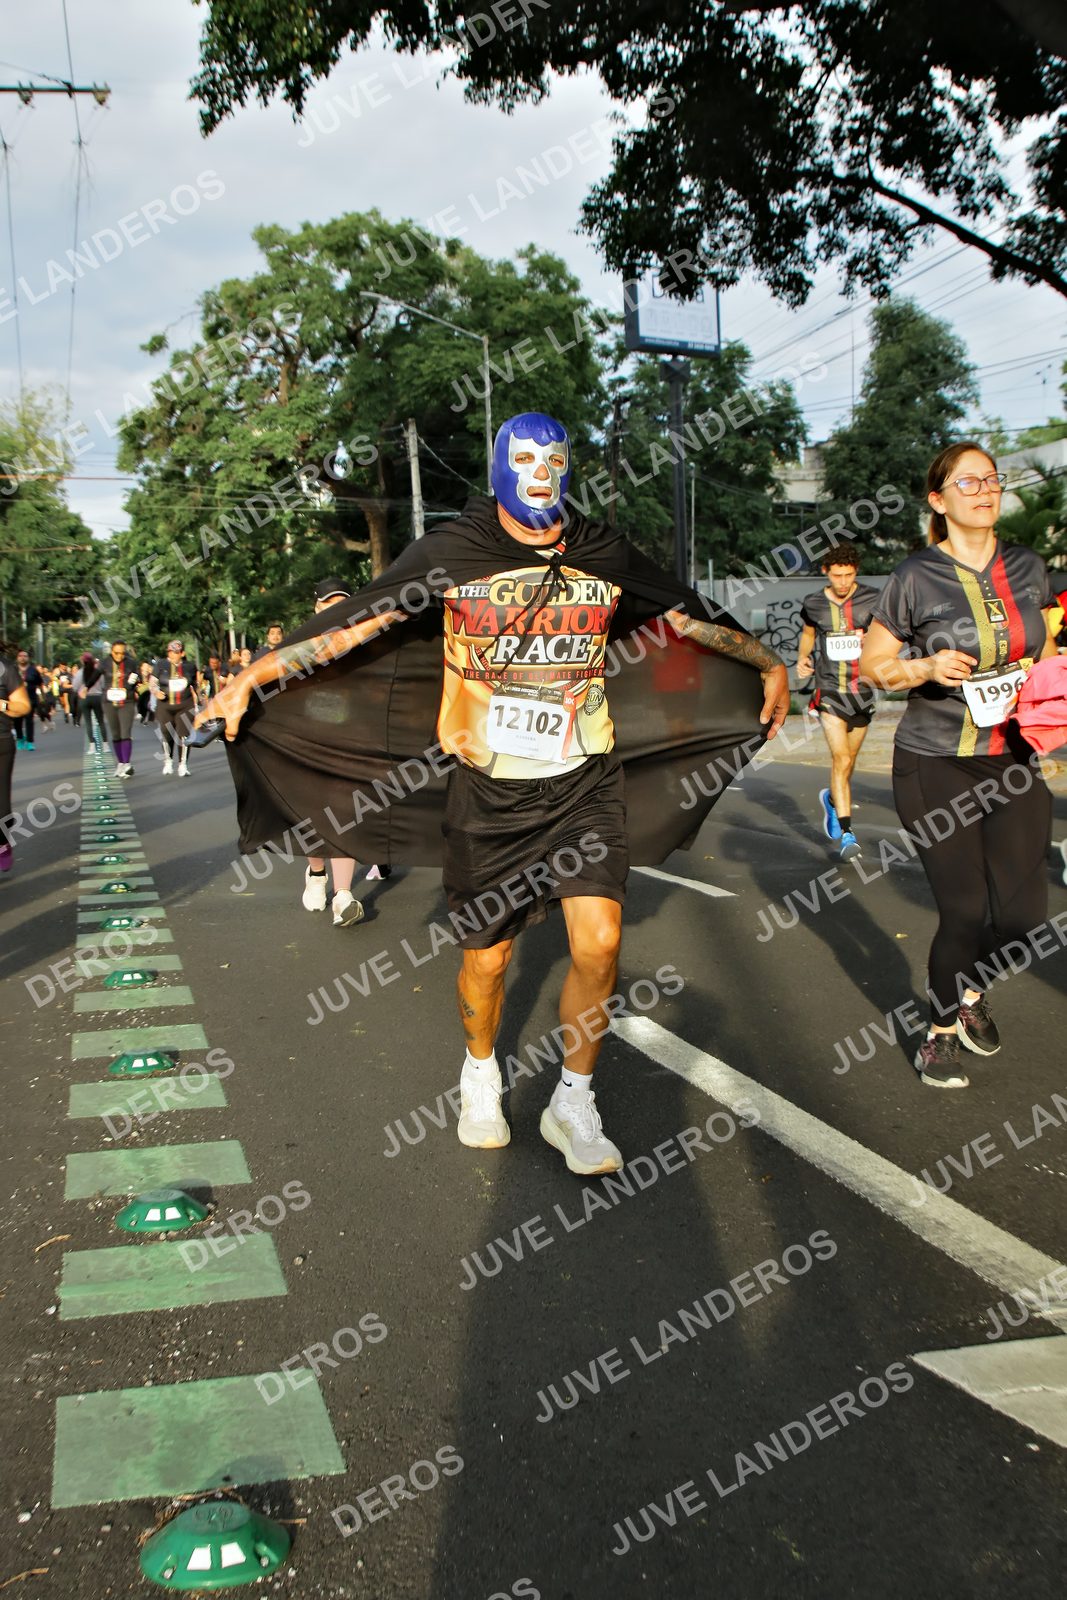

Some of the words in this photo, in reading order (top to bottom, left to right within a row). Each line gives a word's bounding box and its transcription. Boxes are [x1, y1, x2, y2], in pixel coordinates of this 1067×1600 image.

[460, 585, 490, 598] THE
[493, 635, 592, 663] RACE
[830, 639, 859, 650] 10300
[465, 670, 480, 679] THE
[512, 672, 523, 681] OF
[494, 704, 563, 737] 12102
